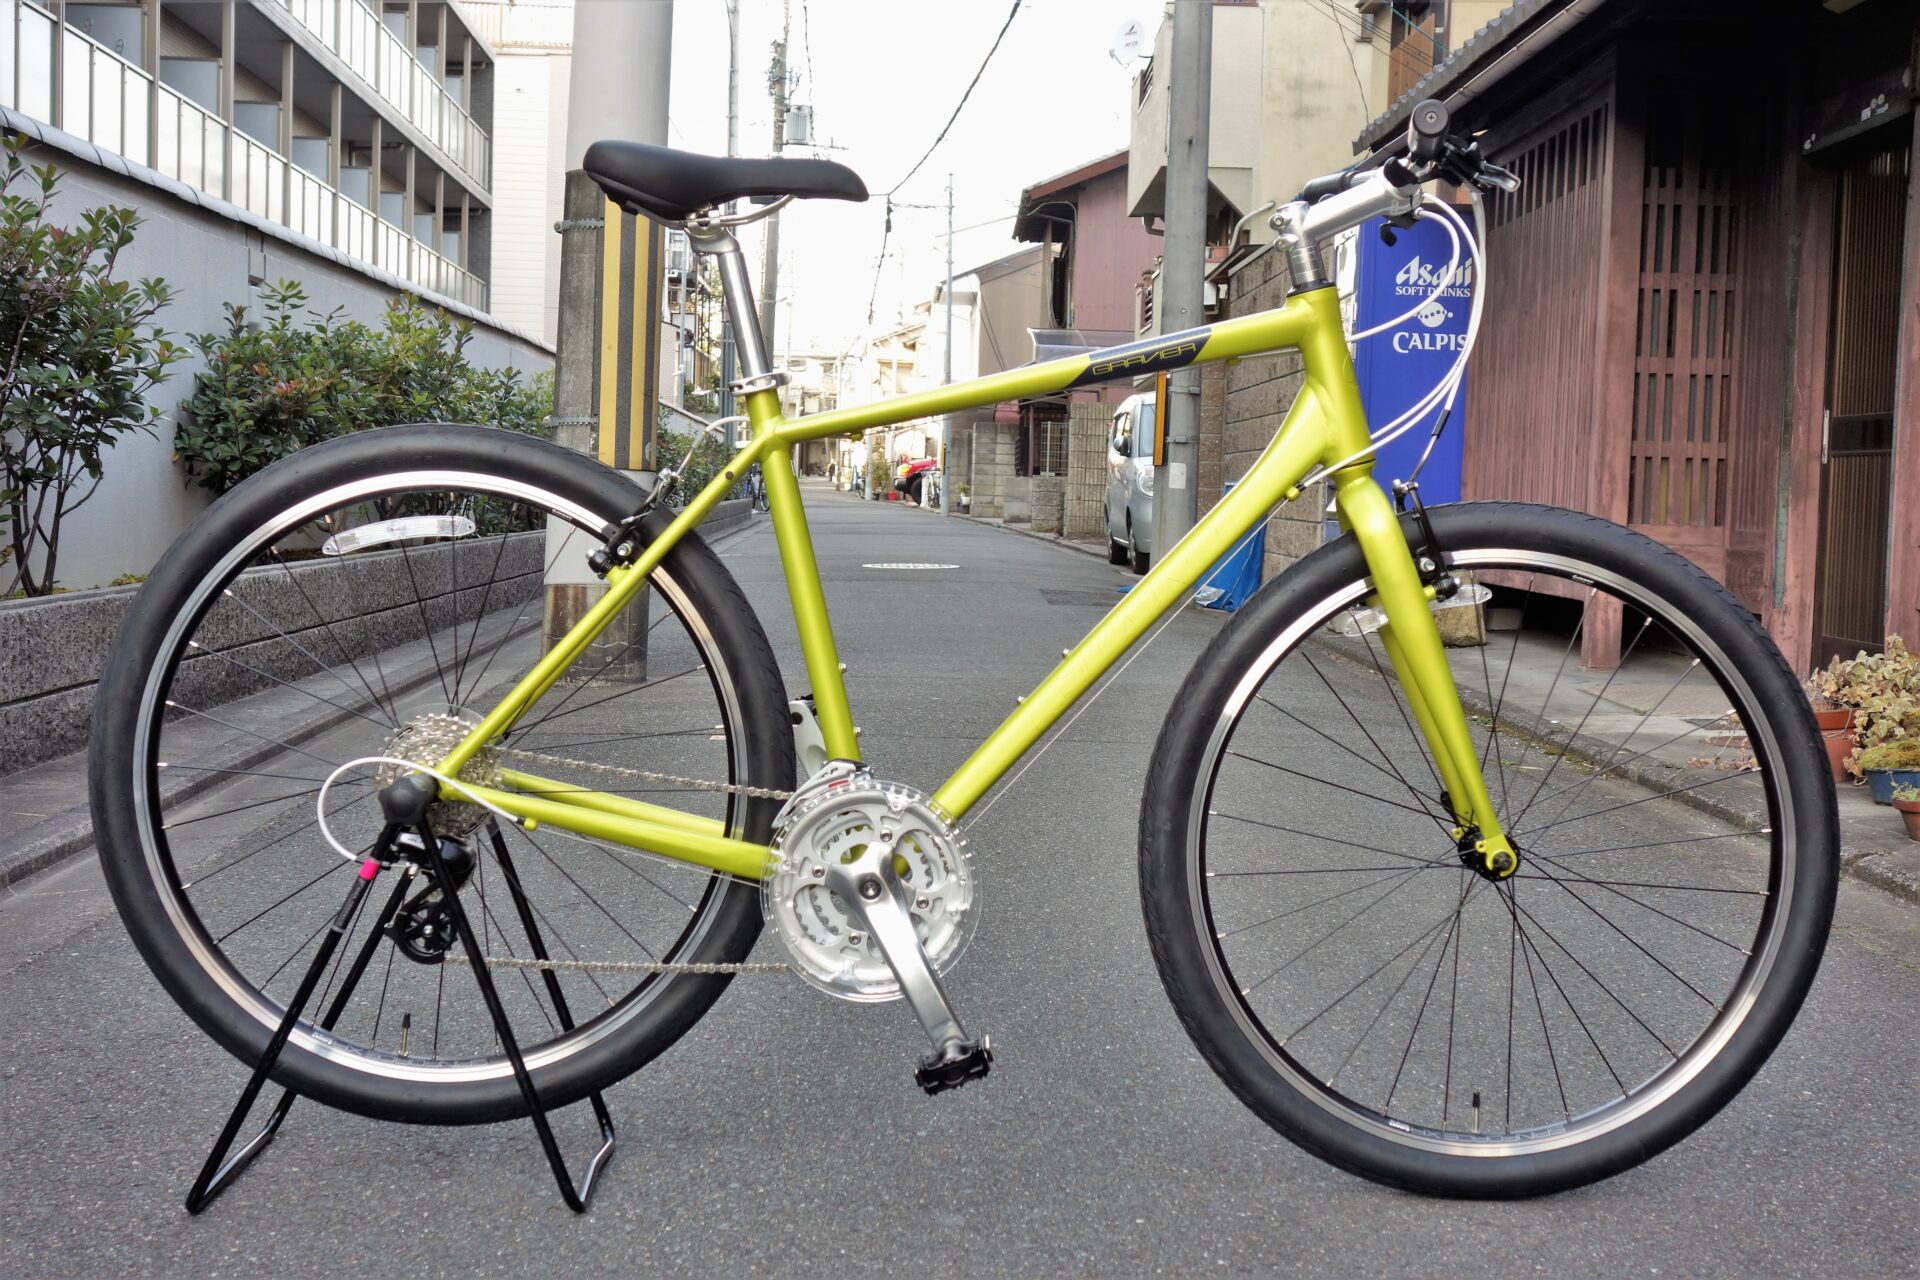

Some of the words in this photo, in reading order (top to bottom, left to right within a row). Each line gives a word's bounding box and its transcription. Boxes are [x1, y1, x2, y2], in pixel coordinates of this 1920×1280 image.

[1395, 255, 1472, 287] Asahi
[1395, 286, 1425, 296] SOFT
[1427, 287, 1471, 298] DINKS
[1392, 331, 1468, 354] CALPIS
[1092, 342, 1197, 376] GRAVIER
